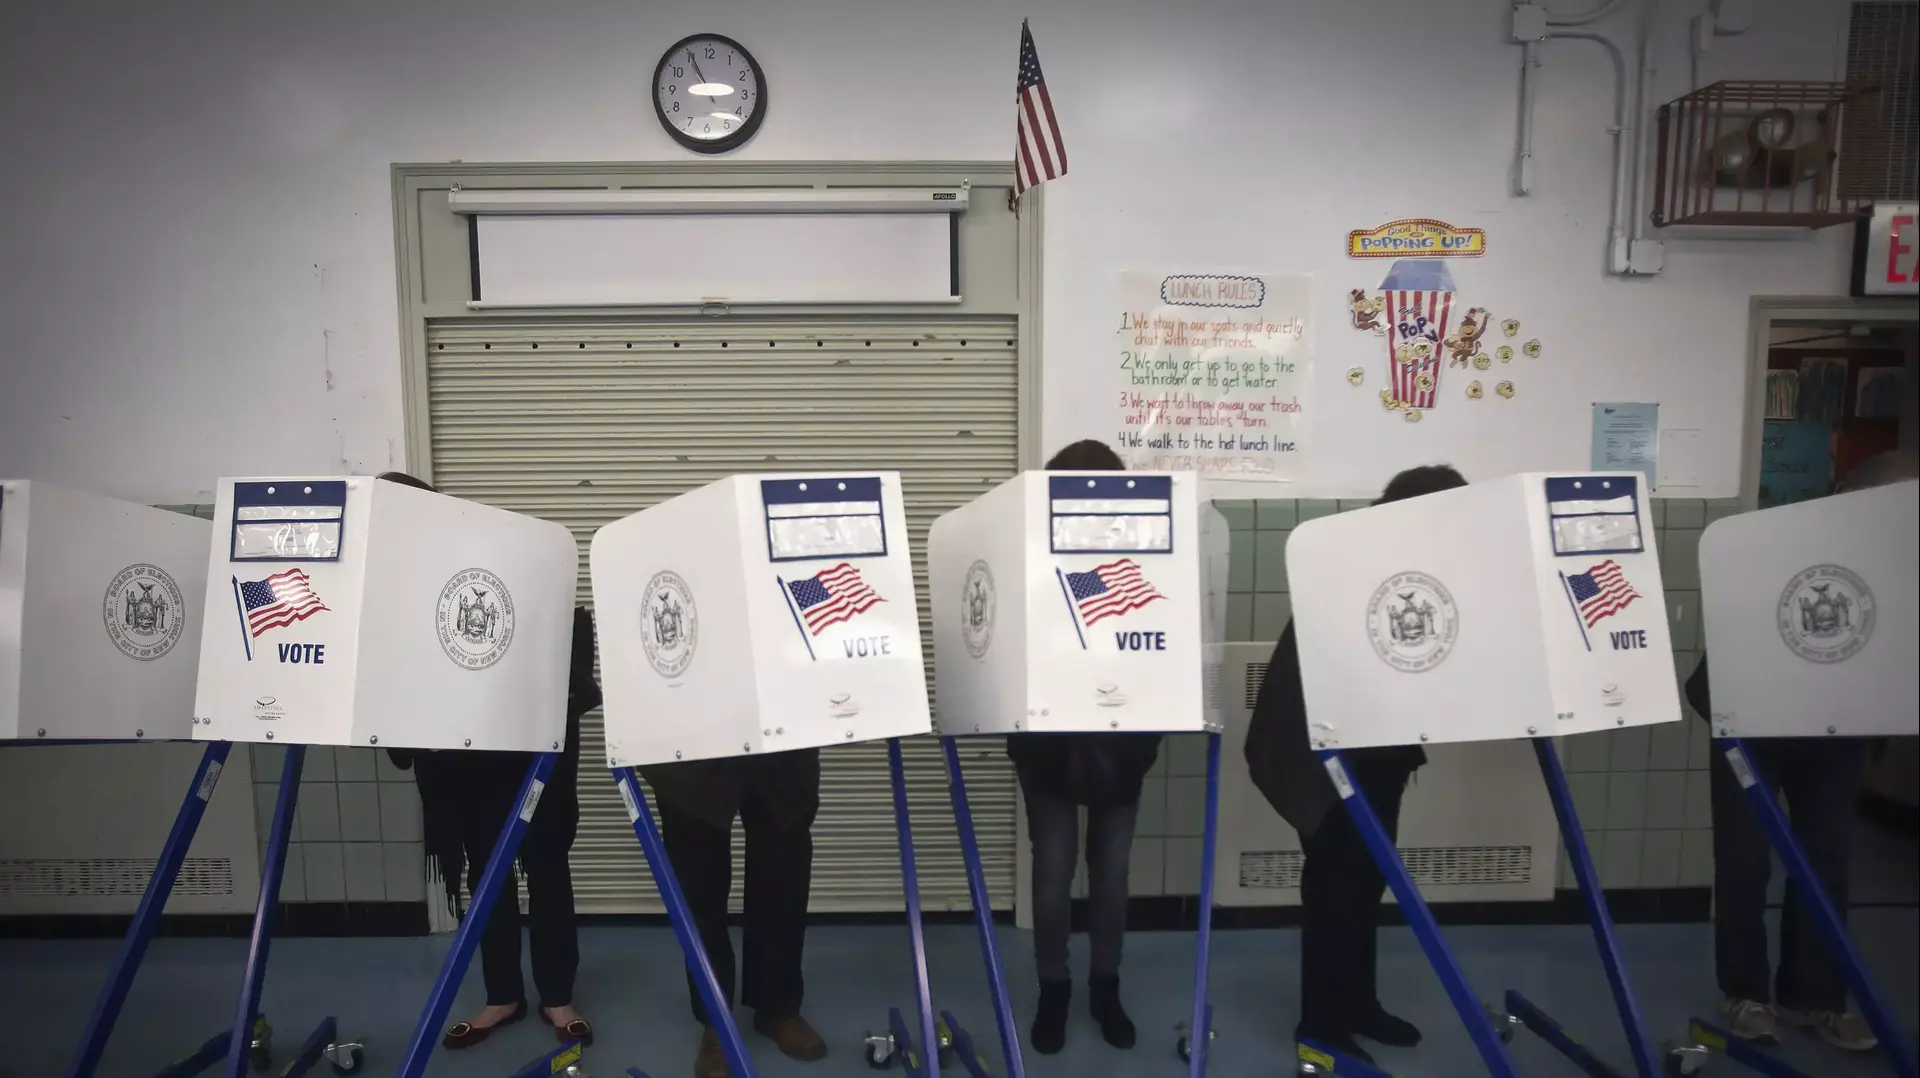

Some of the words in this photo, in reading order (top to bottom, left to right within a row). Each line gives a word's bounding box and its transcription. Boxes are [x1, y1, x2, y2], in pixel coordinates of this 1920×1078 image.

[704, 48, 715, 60] 12
[728, 54, 732, 66] 1
[673, 66, 684, 78] 10
[739, 70, 746, 82] 2
[669, 85, 676, 95] 9
[741, 89, 748, 100] 3
[673, 101, 680, 112] 8
[735, 106, 742, 117] 4
[687, 116, 693, 127] 7
[703, 123, 710, 133] 6
[723, 119, 730, 129] 5
[1387, 224, 1411, 236] Good
[1415, 222, 1447, 237] Things
[1441, 234, 1472, 248] UP!
[1171, 281, 1212, 299] LUNCH
[1218, 282, 1257, 300] RULES
[1132, 312, 1148, 330] We
[1153, 314, 1175, 338] stay
[1190, 321, 1206, 332] our
[1242, 315, 1263, 333] and
[1266, 316, 1303, 341] quietly
[1134, 329, 1158, 346] chat
[1164, 330, 1188, 347] with
[1191, 337, 1207, 347] our
[1134, 351, 1151, 370] We
[1155, 353, 1178, 376] only
[1182, 354, 1204, 377] get
[1207, 361, 1221, 377] up
[1224, 355, 1238, 372] to
[1241, 361, 1256, 378] go
[1258, 356, 1270, 373] to
[1274, 355, 1295, 373] the
[1131, 368, 1188, 386] bathroom
[1191, 377, 1203, 386] or
[1207, 373, 1219, 387] to
[1221, 370, 1240, 395] get
[1130, 392, 1145, 409] We
[1169, 392, 1184, 409] to
[1185, 392, 1216, 410] throw
[1218, 401, 1245, 420] away
[1248, 402, 1266, 412] our
[1270, 394, 1302, 413] trash
[1125, 408, 1150, 425] until
[1175, 415, 1192, 426] our
[1128, 431, 1143, 448] We
[1147, 432, 1174, 449] walk
[1177, 432, 1190, 450] to
[1193, 432, 1214, 450] the
[1218, 432, 1236, 450] hot
[1240, 433, 1269, 451] lunch
[842, 635, 892, 658] VOTE
[1115, 631, 1166, 651] VOTE
[1609, 629, 1648, 650] VOTE
[278, 643, 325, 664] VOTE
